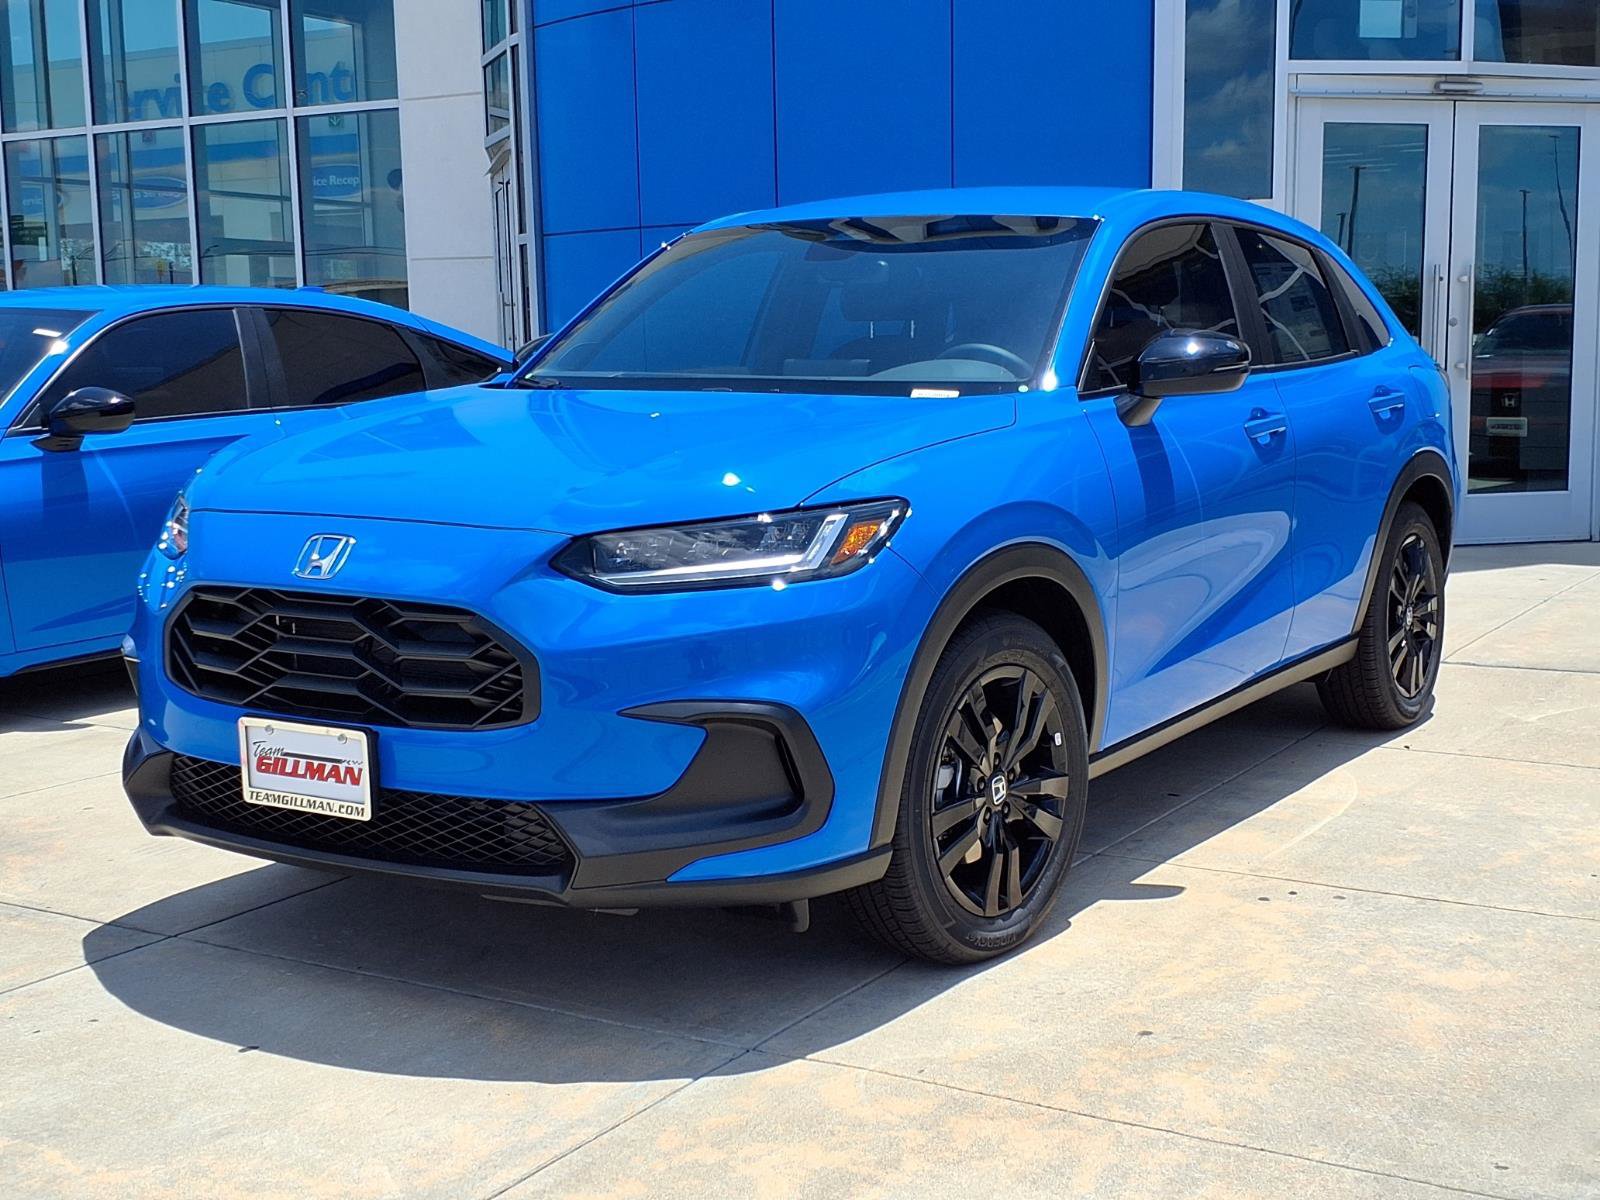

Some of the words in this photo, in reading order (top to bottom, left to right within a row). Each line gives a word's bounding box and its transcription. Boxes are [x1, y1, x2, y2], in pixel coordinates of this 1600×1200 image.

[252, 740, 285, 757] Team
[256, 755, 363, 786] GILLMAN
[249, 790, 365, 818] TEAMGILLMAN.COM
